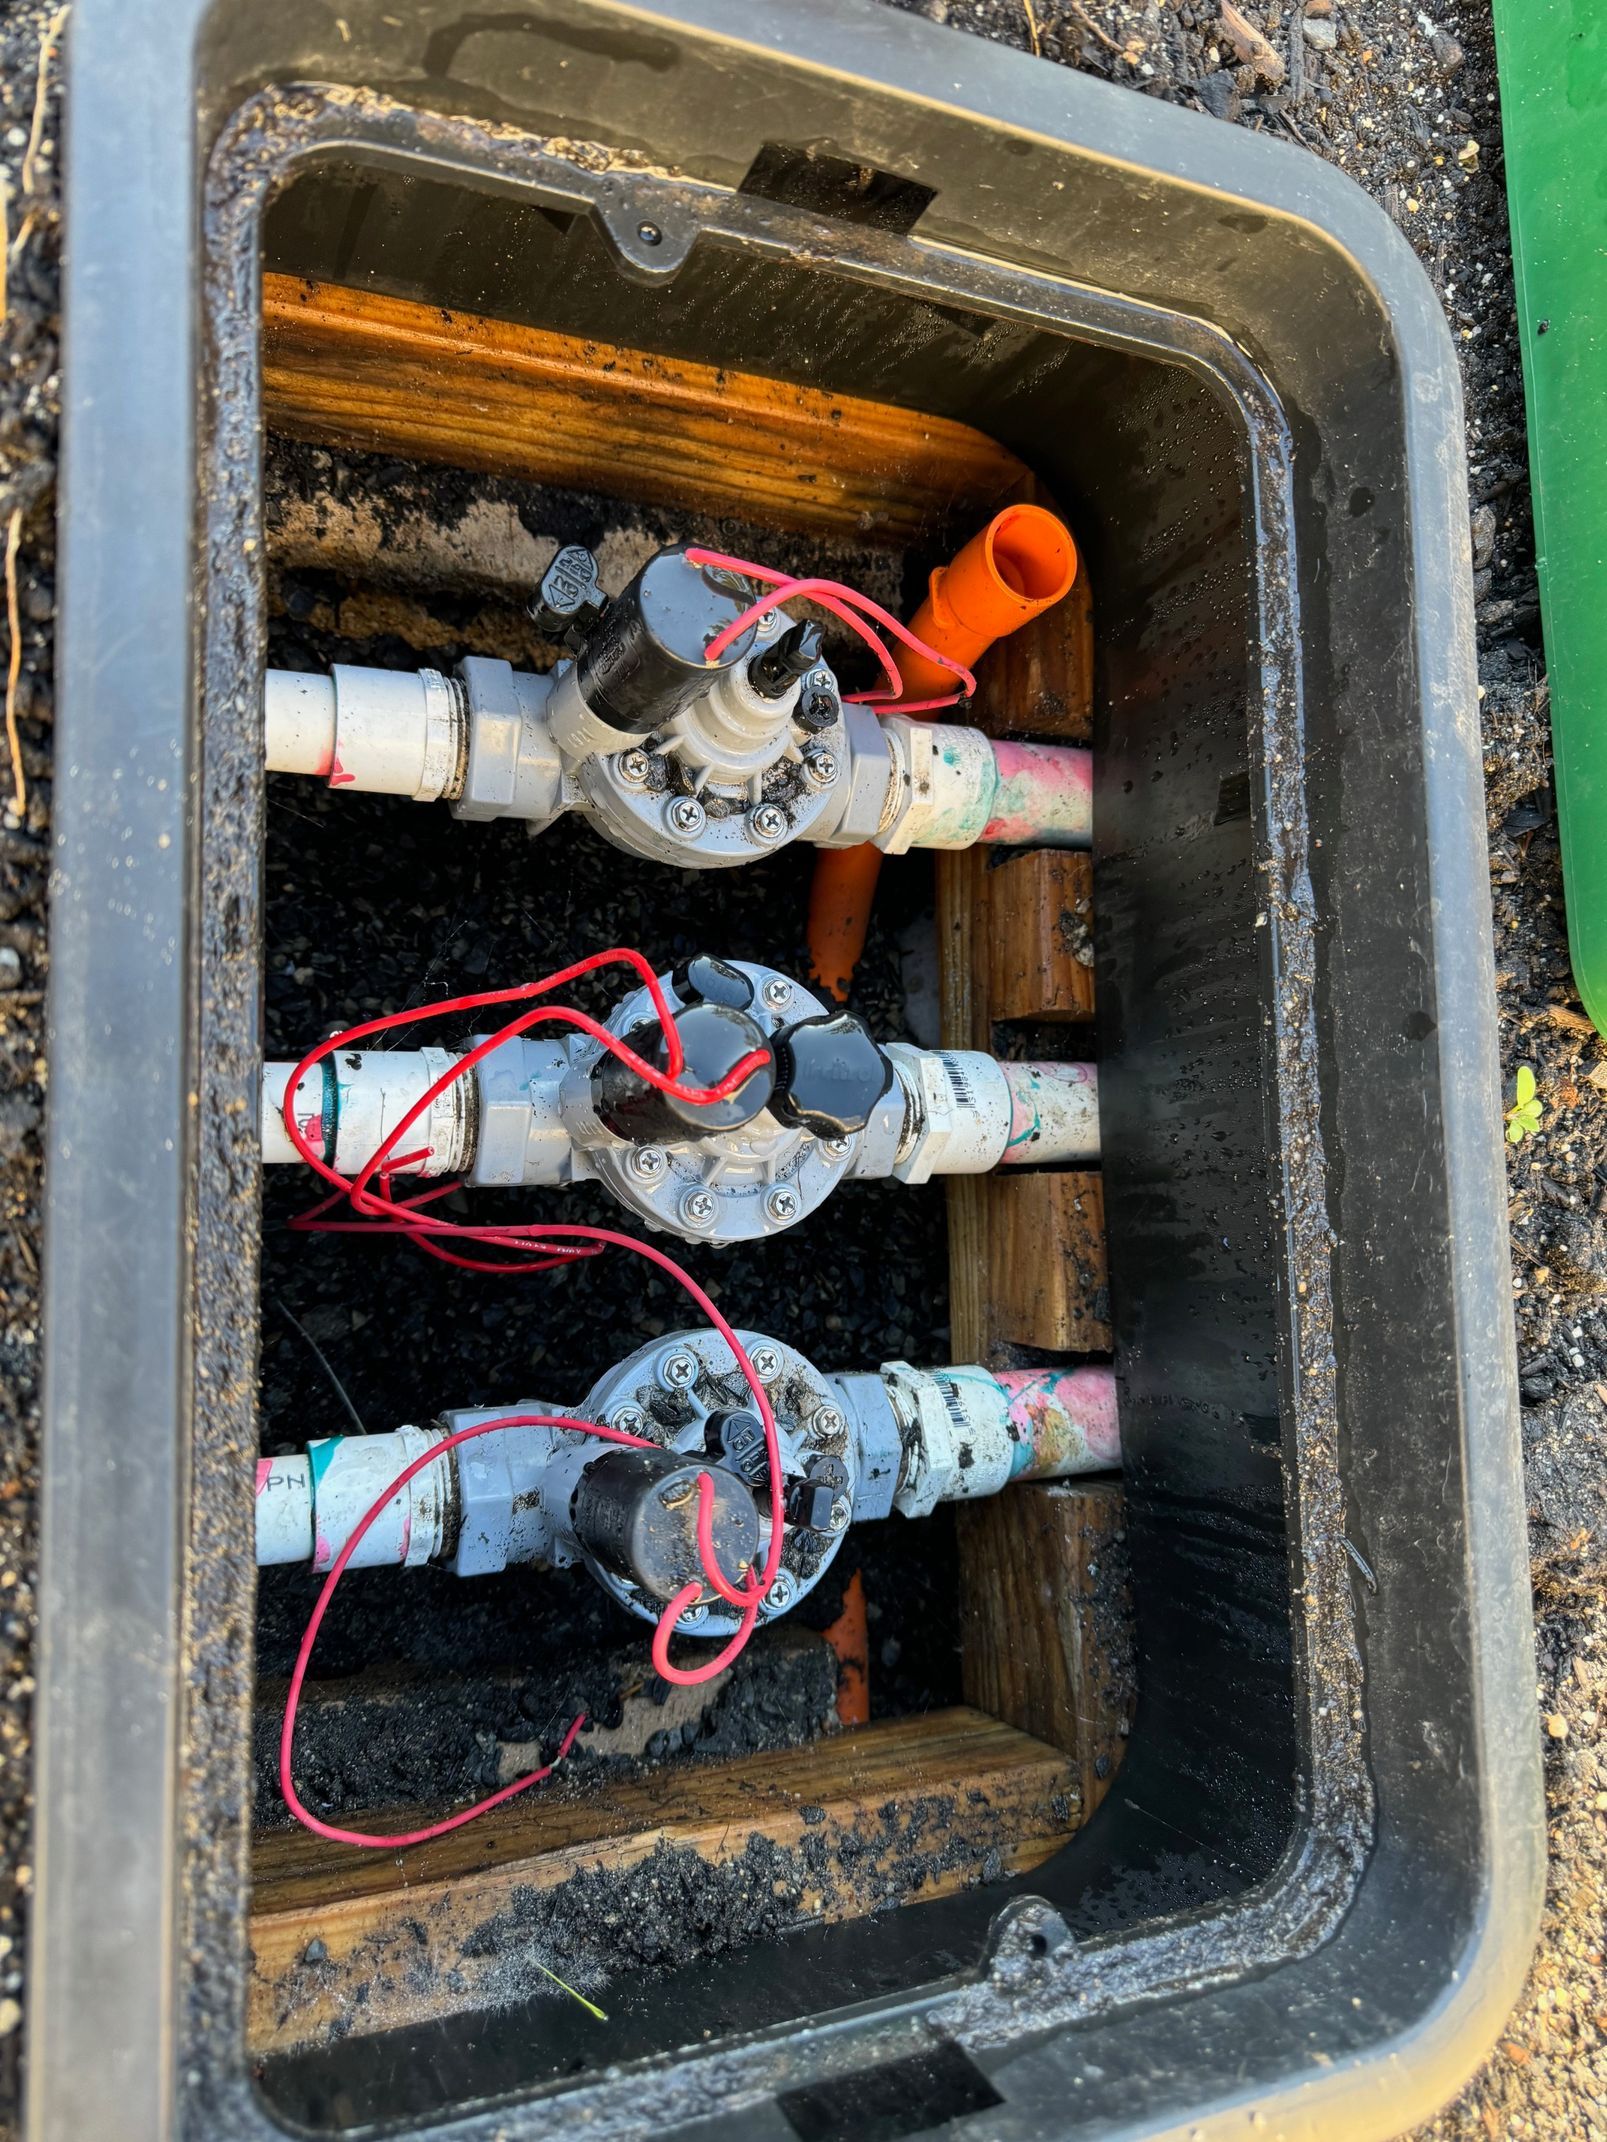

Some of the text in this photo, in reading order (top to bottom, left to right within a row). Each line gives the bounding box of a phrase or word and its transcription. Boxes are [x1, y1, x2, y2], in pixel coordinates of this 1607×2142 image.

[553, 576, 580, 598] ON
[732, 1429, 756, 1453] ON
[266, 1473, 306, 1492] PN
